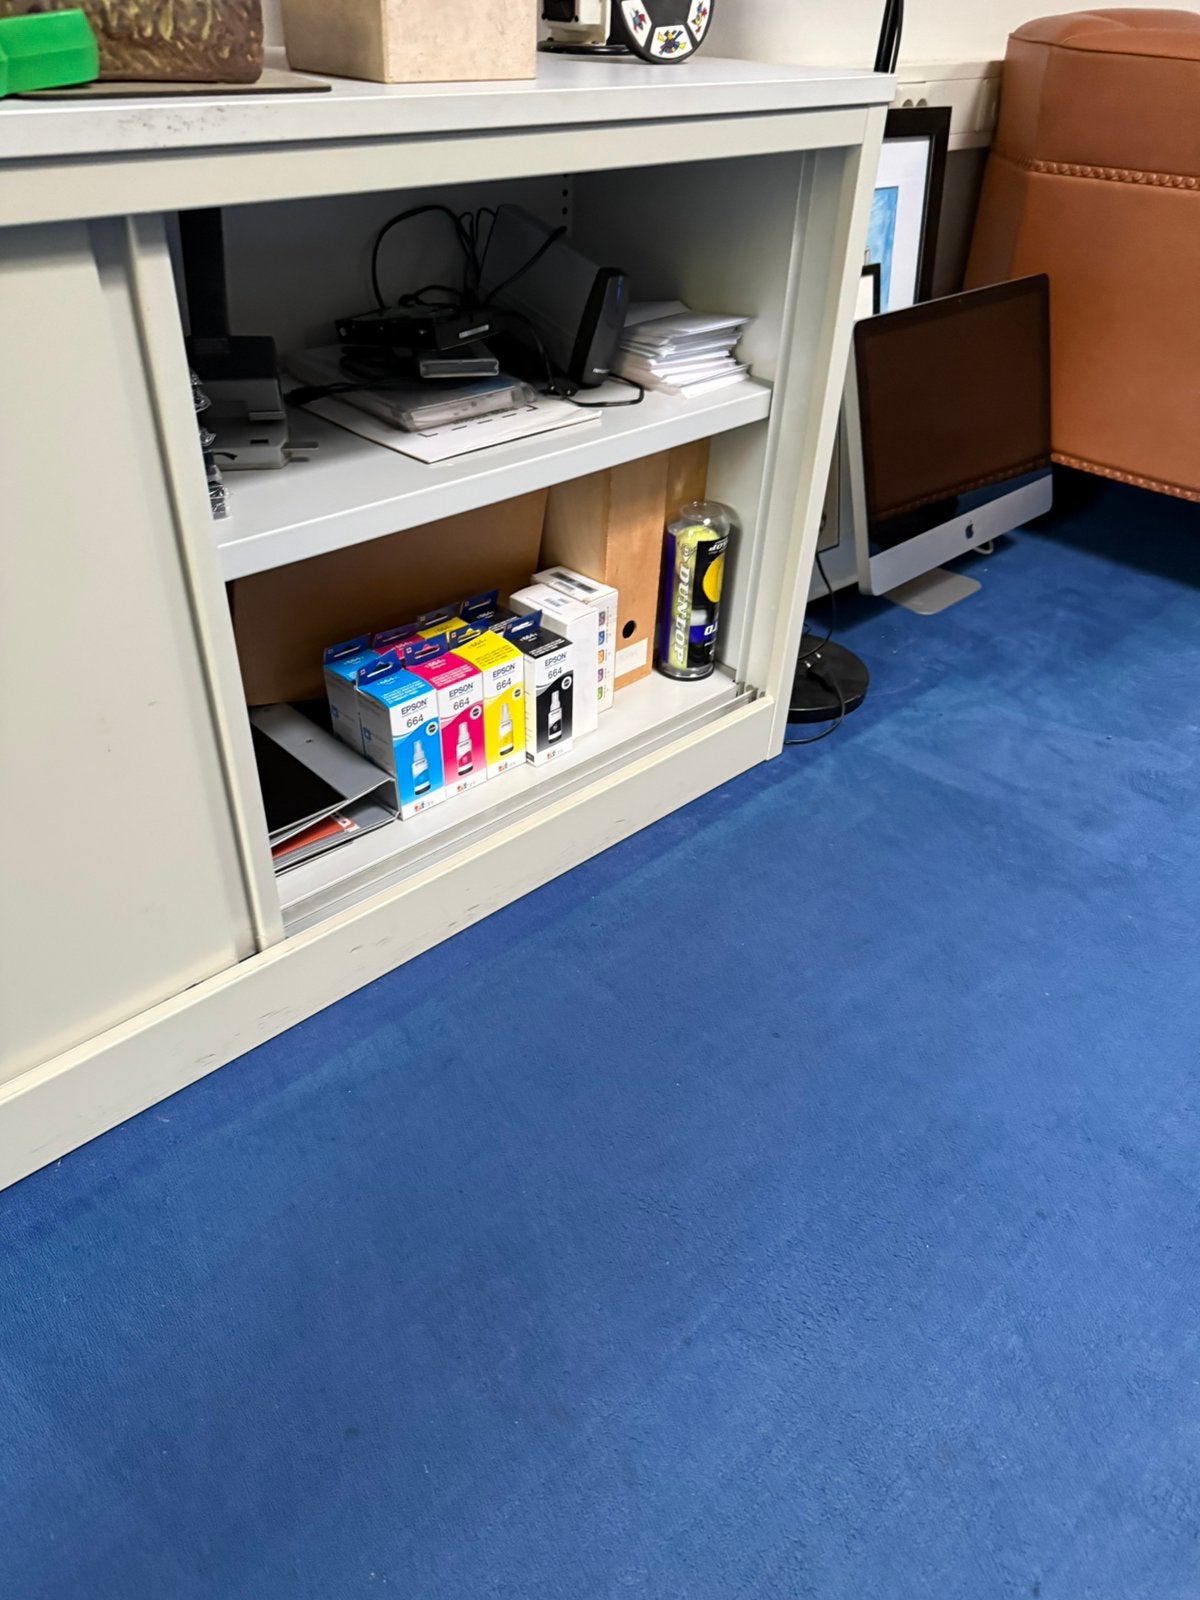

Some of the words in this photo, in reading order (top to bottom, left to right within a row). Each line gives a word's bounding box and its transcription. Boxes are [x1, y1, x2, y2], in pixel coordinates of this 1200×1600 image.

[674, 562, 690, 662] DUNLOP
[544, 653, 567, 667] EPSON
[492, 664, 516, 678] EPSON
[548, 667, 562, 679] 664
[449, 682, 474, 698] EPSON
[496, 678, 512, 691] 664
[401, 698, 428, 715] EPSON
[453, 697, 470, 710] 664
[406, 714, 424, 728] 664
